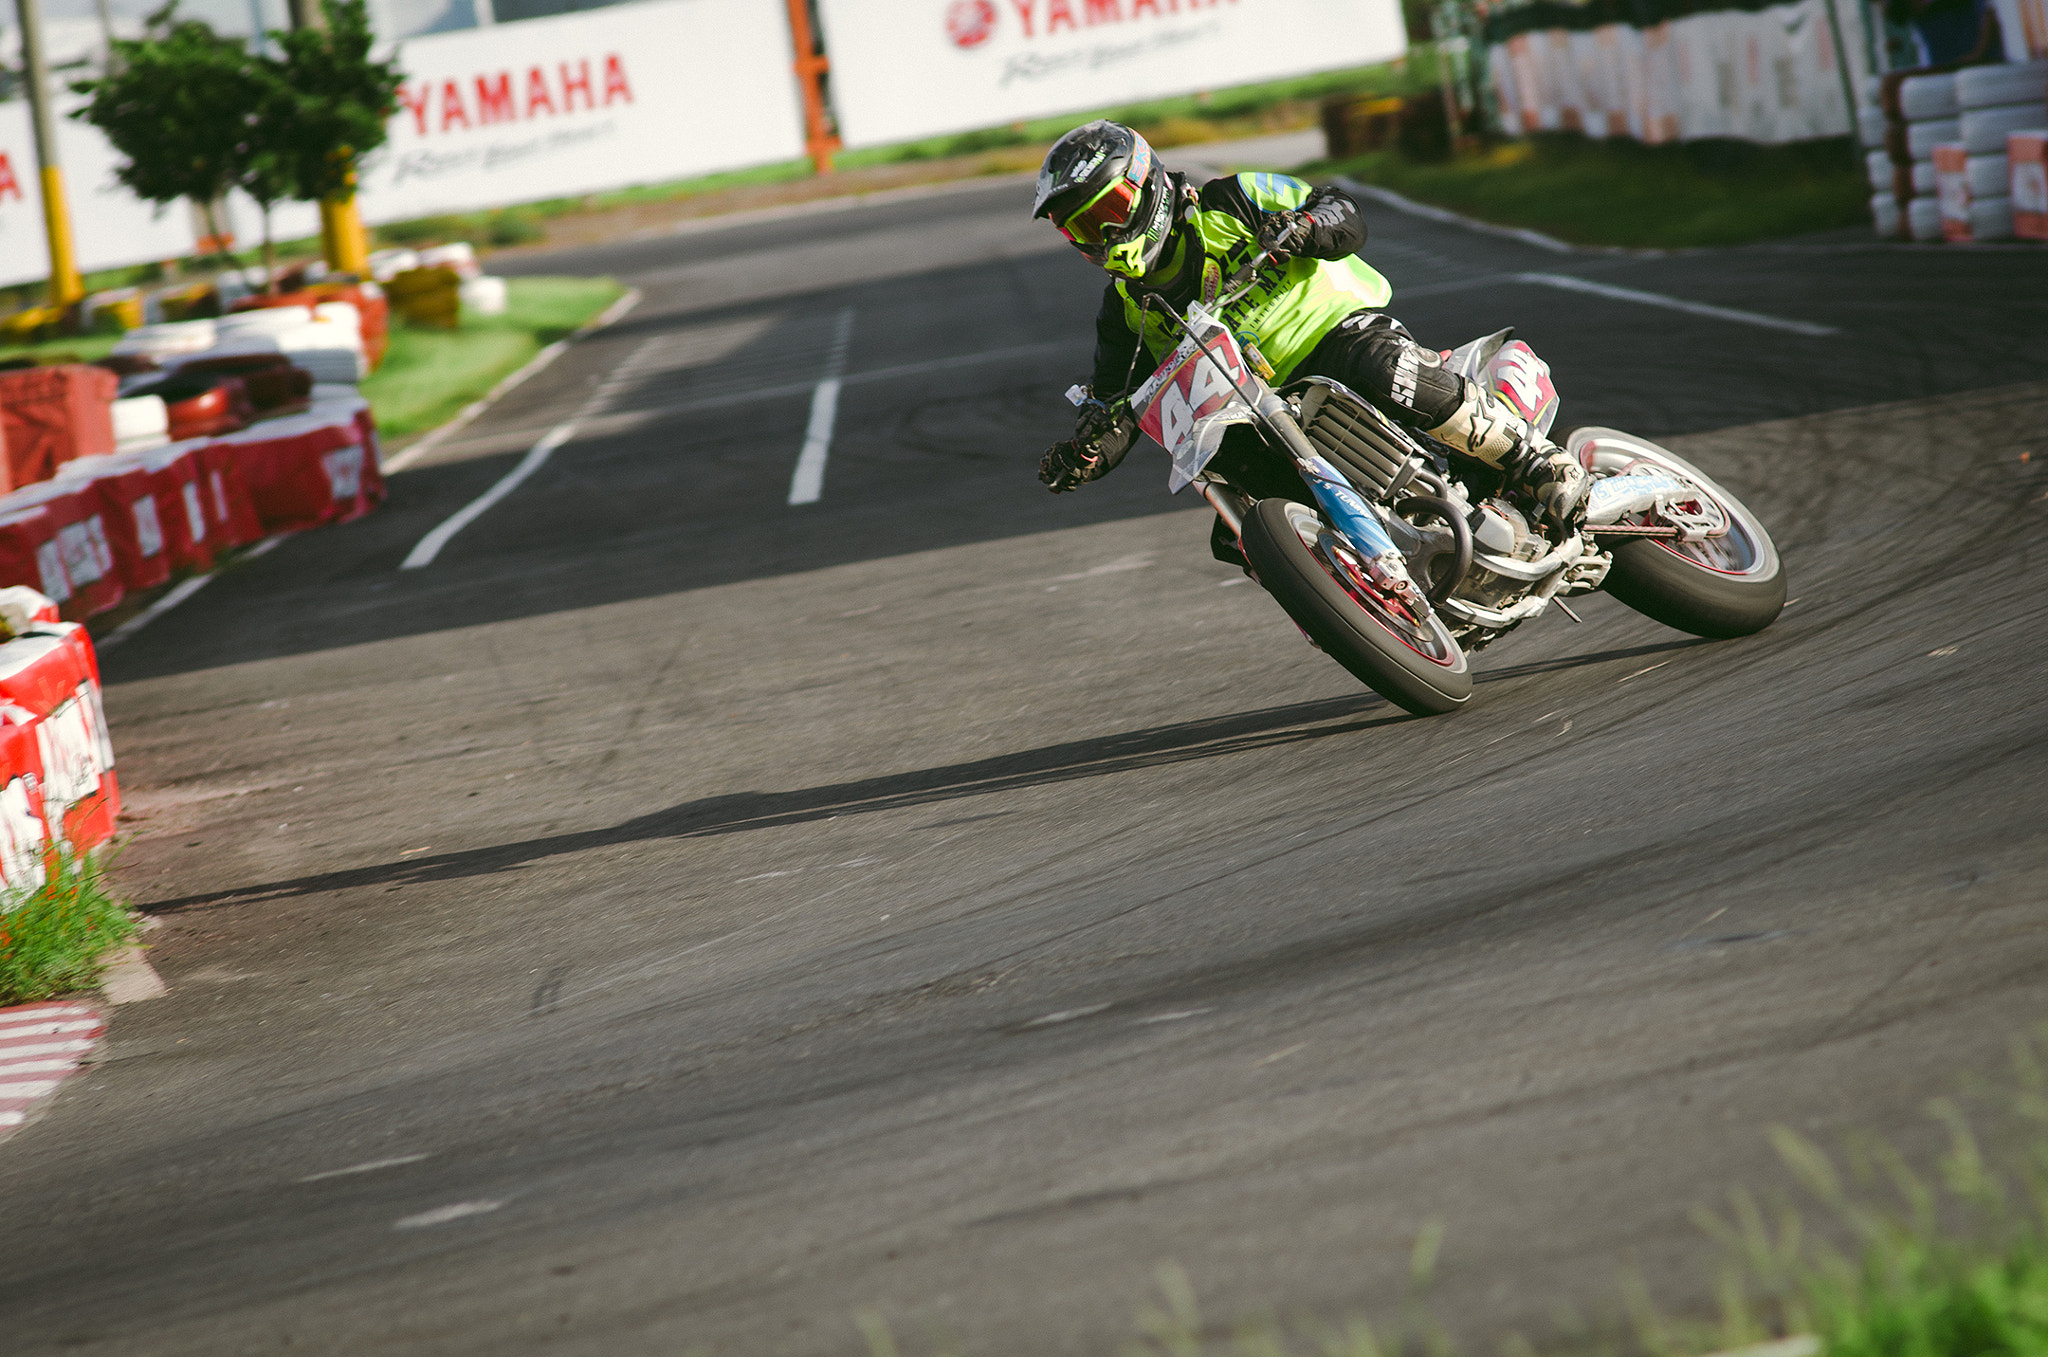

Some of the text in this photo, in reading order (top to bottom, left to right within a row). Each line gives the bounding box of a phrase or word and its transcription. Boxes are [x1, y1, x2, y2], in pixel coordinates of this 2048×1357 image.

[402, 52, 634, 137] YAMAHA
[1249, 280, 1292, 329] INTEGRITY
[1160, 345, 1241, 454] 44
[1390, 340, 1420, 408] SHI
